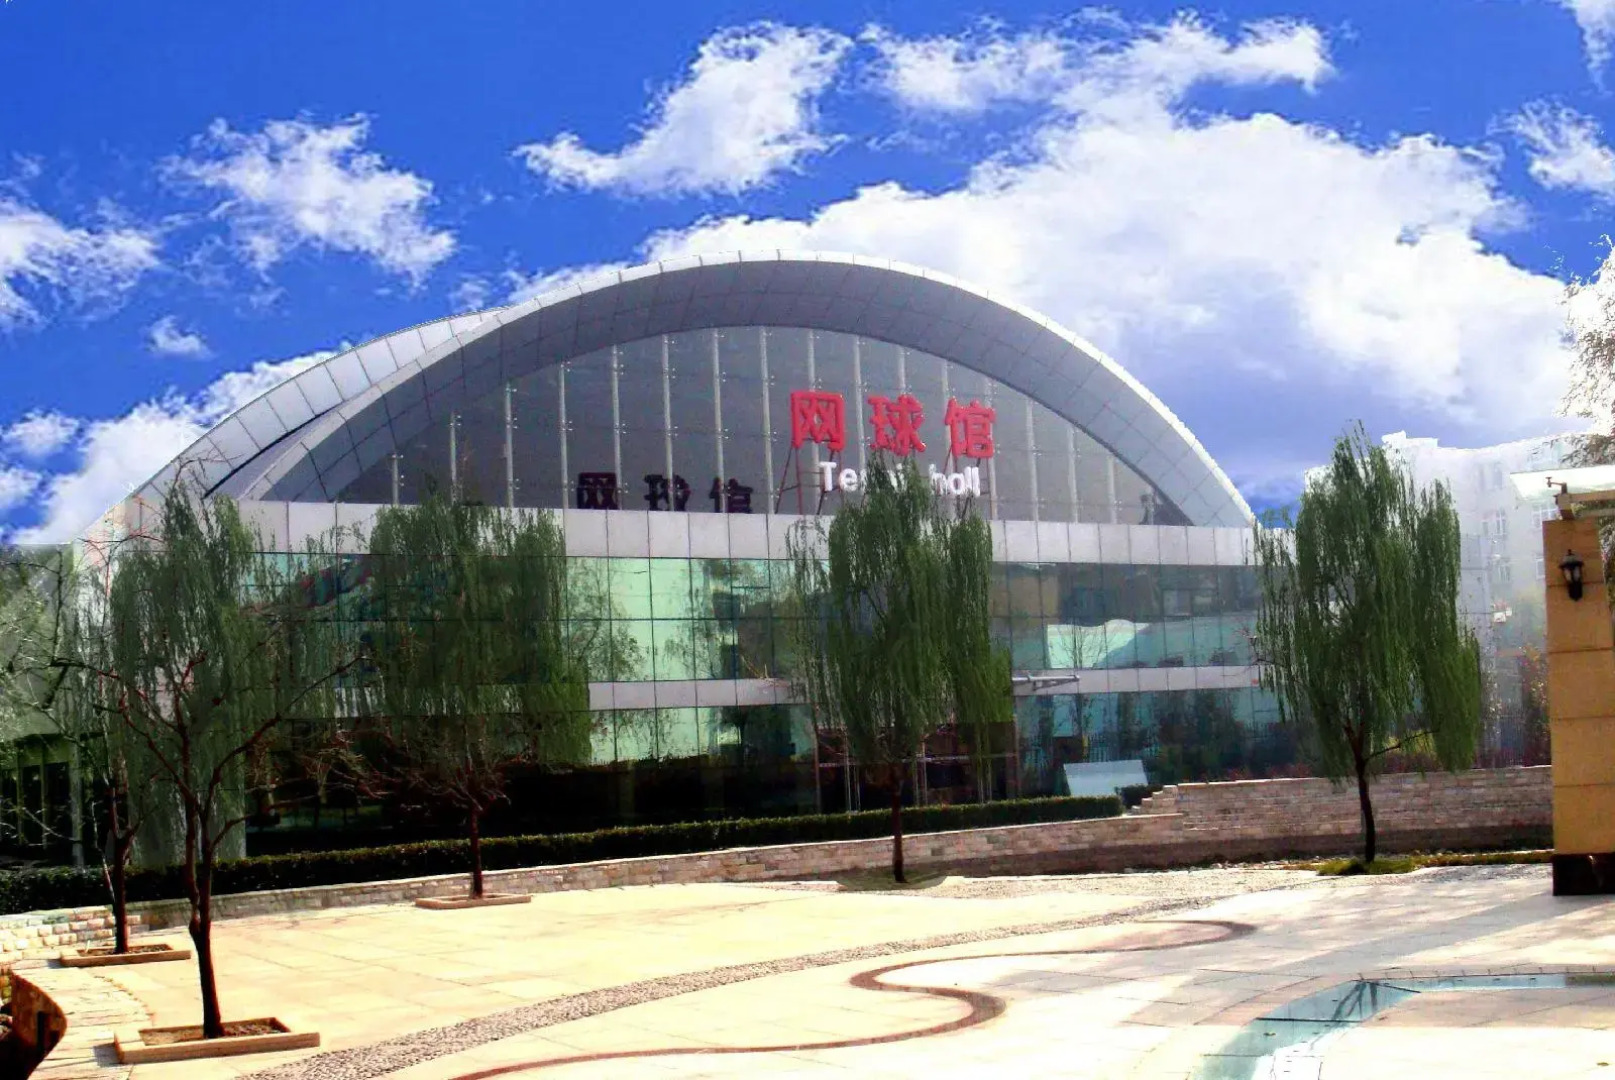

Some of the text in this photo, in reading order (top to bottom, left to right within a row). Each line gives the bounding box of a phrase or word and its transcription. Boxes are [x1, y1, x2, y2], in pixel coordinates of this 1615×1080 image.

[791, 391, 996, 458] 网球馆
[819, 461, 919, 496] Tei
